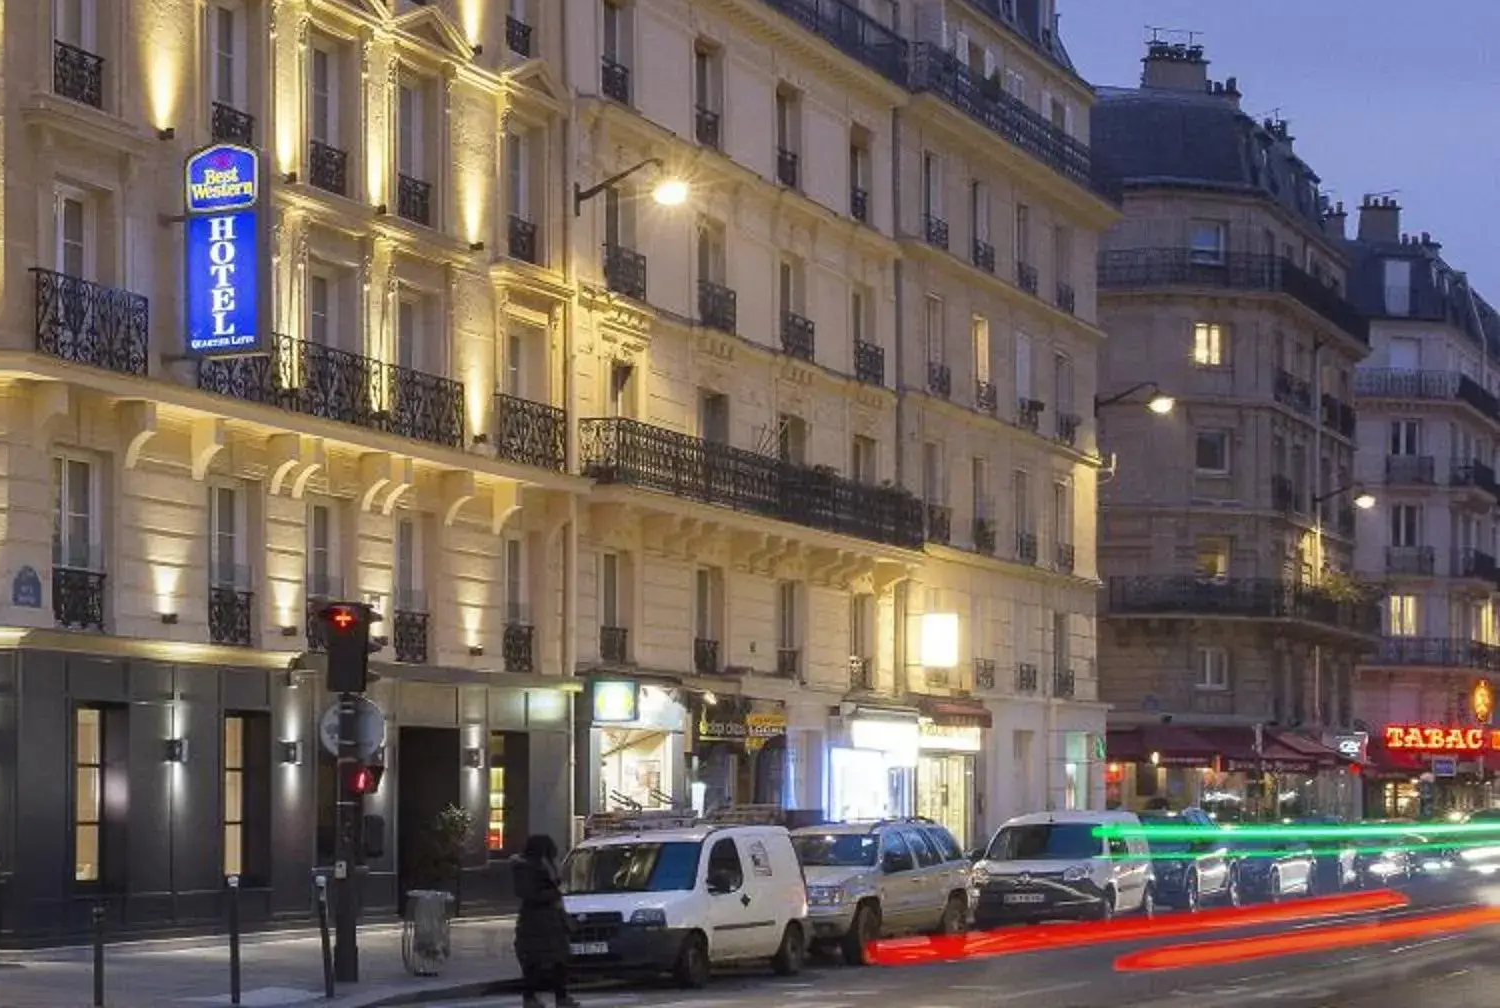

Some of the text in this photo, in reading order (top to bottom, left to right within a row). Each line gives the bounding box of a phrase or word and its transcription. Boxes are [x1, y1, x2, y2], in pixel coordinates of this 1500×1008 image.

[204, 166, 238, 186] Best
[191, 181, 253, 200] Western
[209, 217, 236, 335] HOTEL
[1386, 726, 1483, 749] TABAC
